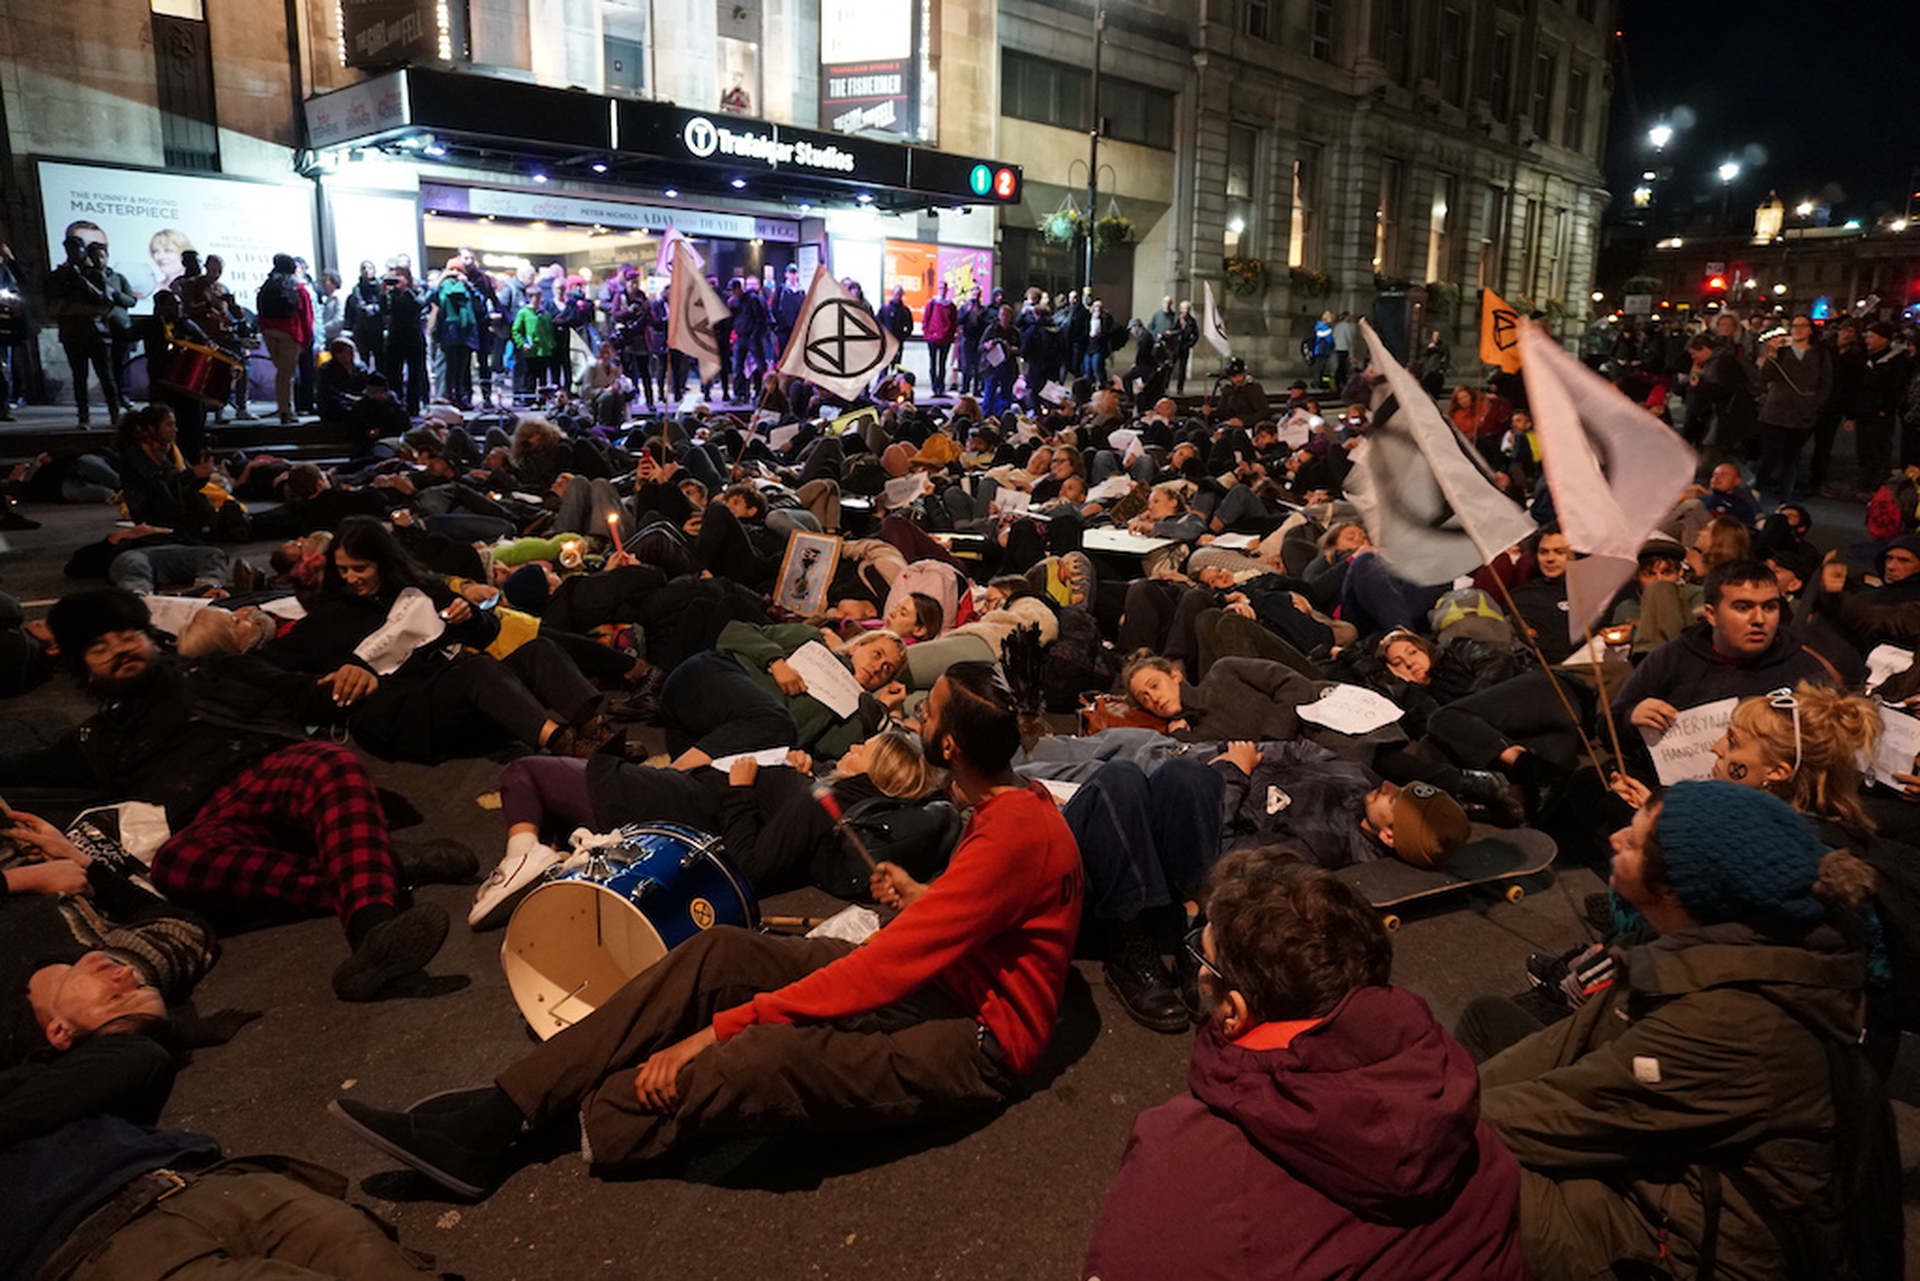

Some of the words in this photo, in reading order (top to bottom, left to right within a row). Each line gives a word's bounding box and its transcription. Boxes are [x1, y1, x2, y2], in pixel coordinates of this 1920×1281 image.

[401, 9, 424, 47] FELL
[829, 78, 847, 98] THE
[847, 74, 901, 96] FISHERMEN
[875, 99, 896, 128] FELL
[718, 128, 793, 164] Trafalgar
[794, 141, 855, 172] Studios
[976, 168, 985, 191] 1
[998, 172, 1011, 194] 2
[69, 190, 91, 199] THE
[93, 192, 127, 202] FUNNY
[137, 196, 178, 207] MOVING
[70, 200, 180, 220] MASTERPIECE
[581, 208, 605, 218] PETER
[606, 210, 639, 221] NICHOLS
[700, 218, 738, 232] DEATH
